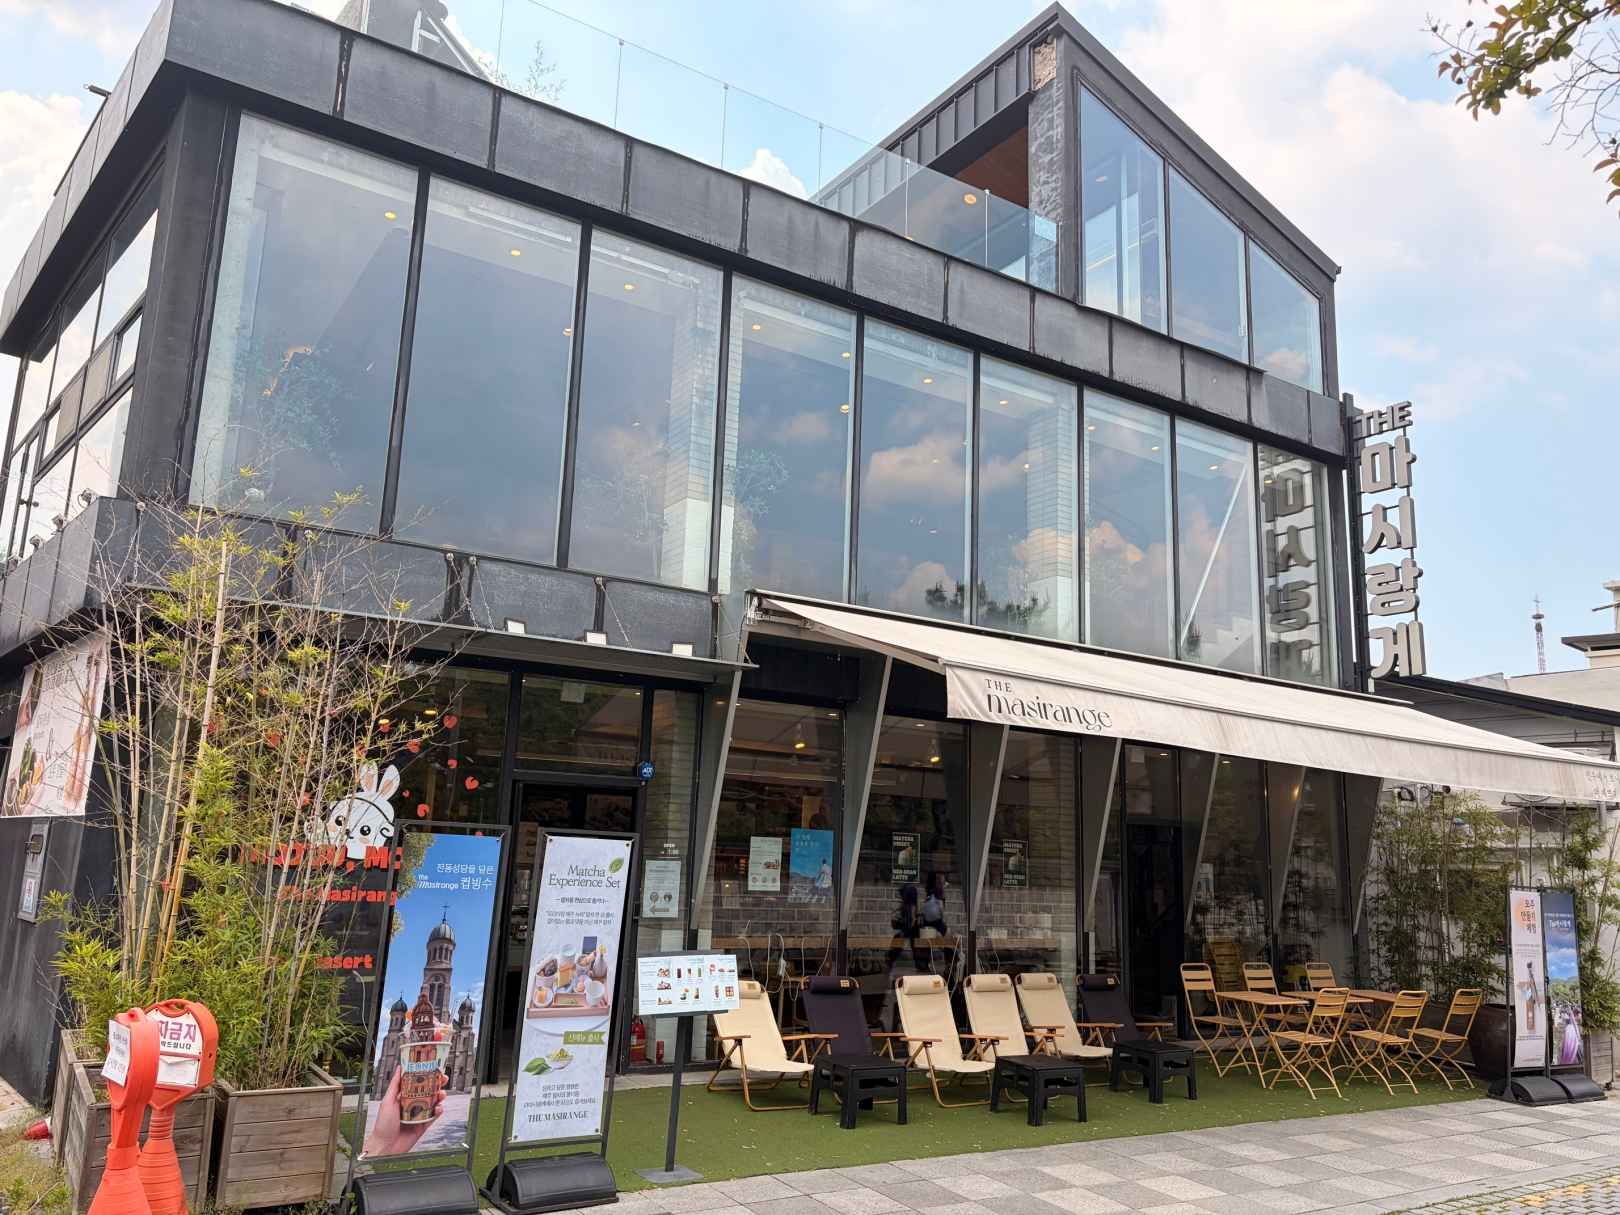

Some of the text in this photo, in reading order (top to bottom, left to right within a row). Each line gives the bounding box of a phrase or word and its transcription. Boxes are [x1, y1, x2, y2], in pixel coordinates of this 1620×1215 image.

[1354, 400, 1413, 440] THE
[1358, 435, 1427, 680] 마시랑게
[984, 679, 1013, 693] THE
[567, 864, 606, 878] Matcha
[548, 873, 621, 888] Experience Set
[158, 1020, 197, 1043] 차금지
[544, 1110, 589, 1122] MASIRANGE
